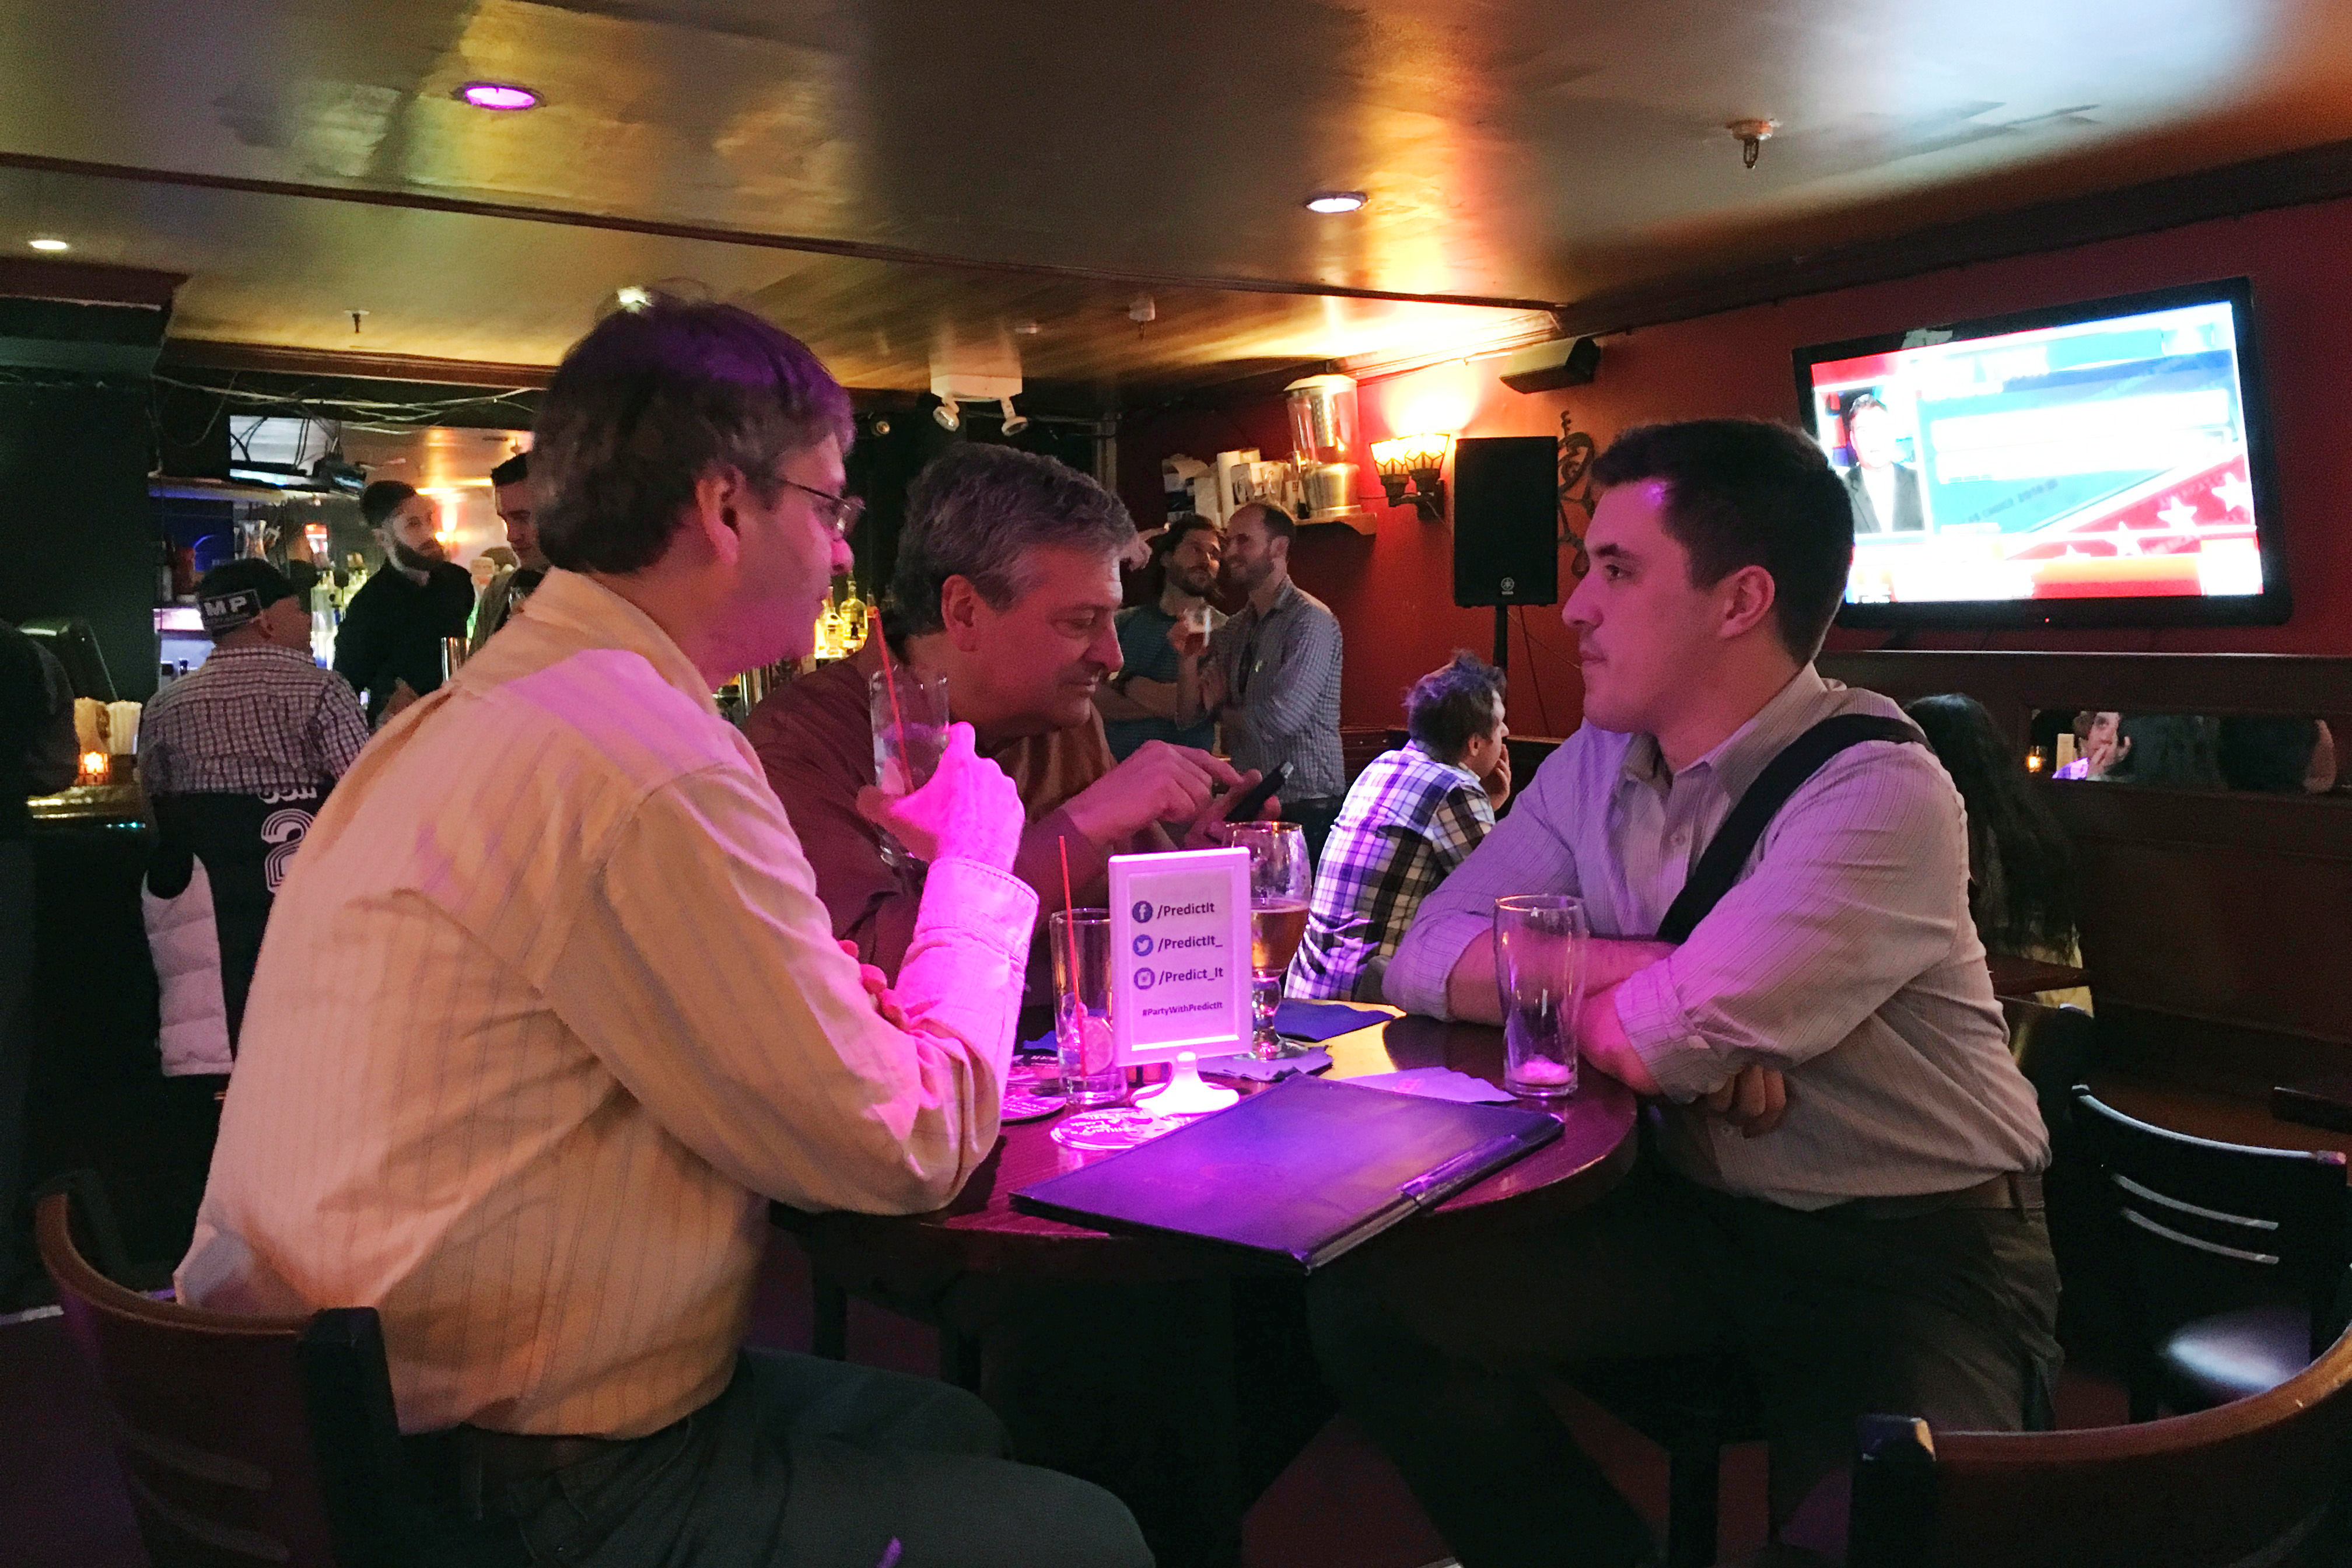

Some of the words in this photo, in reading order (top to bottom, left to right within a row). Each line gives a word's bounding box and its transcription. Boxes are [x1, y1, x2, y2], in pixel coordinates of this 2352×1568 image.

[1157, 902, 1215, 919] /PredictIt
[1157, 935, 1223, 953] /PredictIt_
[1158, 967, 1224, 985] /Predict_It
[1142, 1001, 1223, 1016] #PartyWithPredictIt
